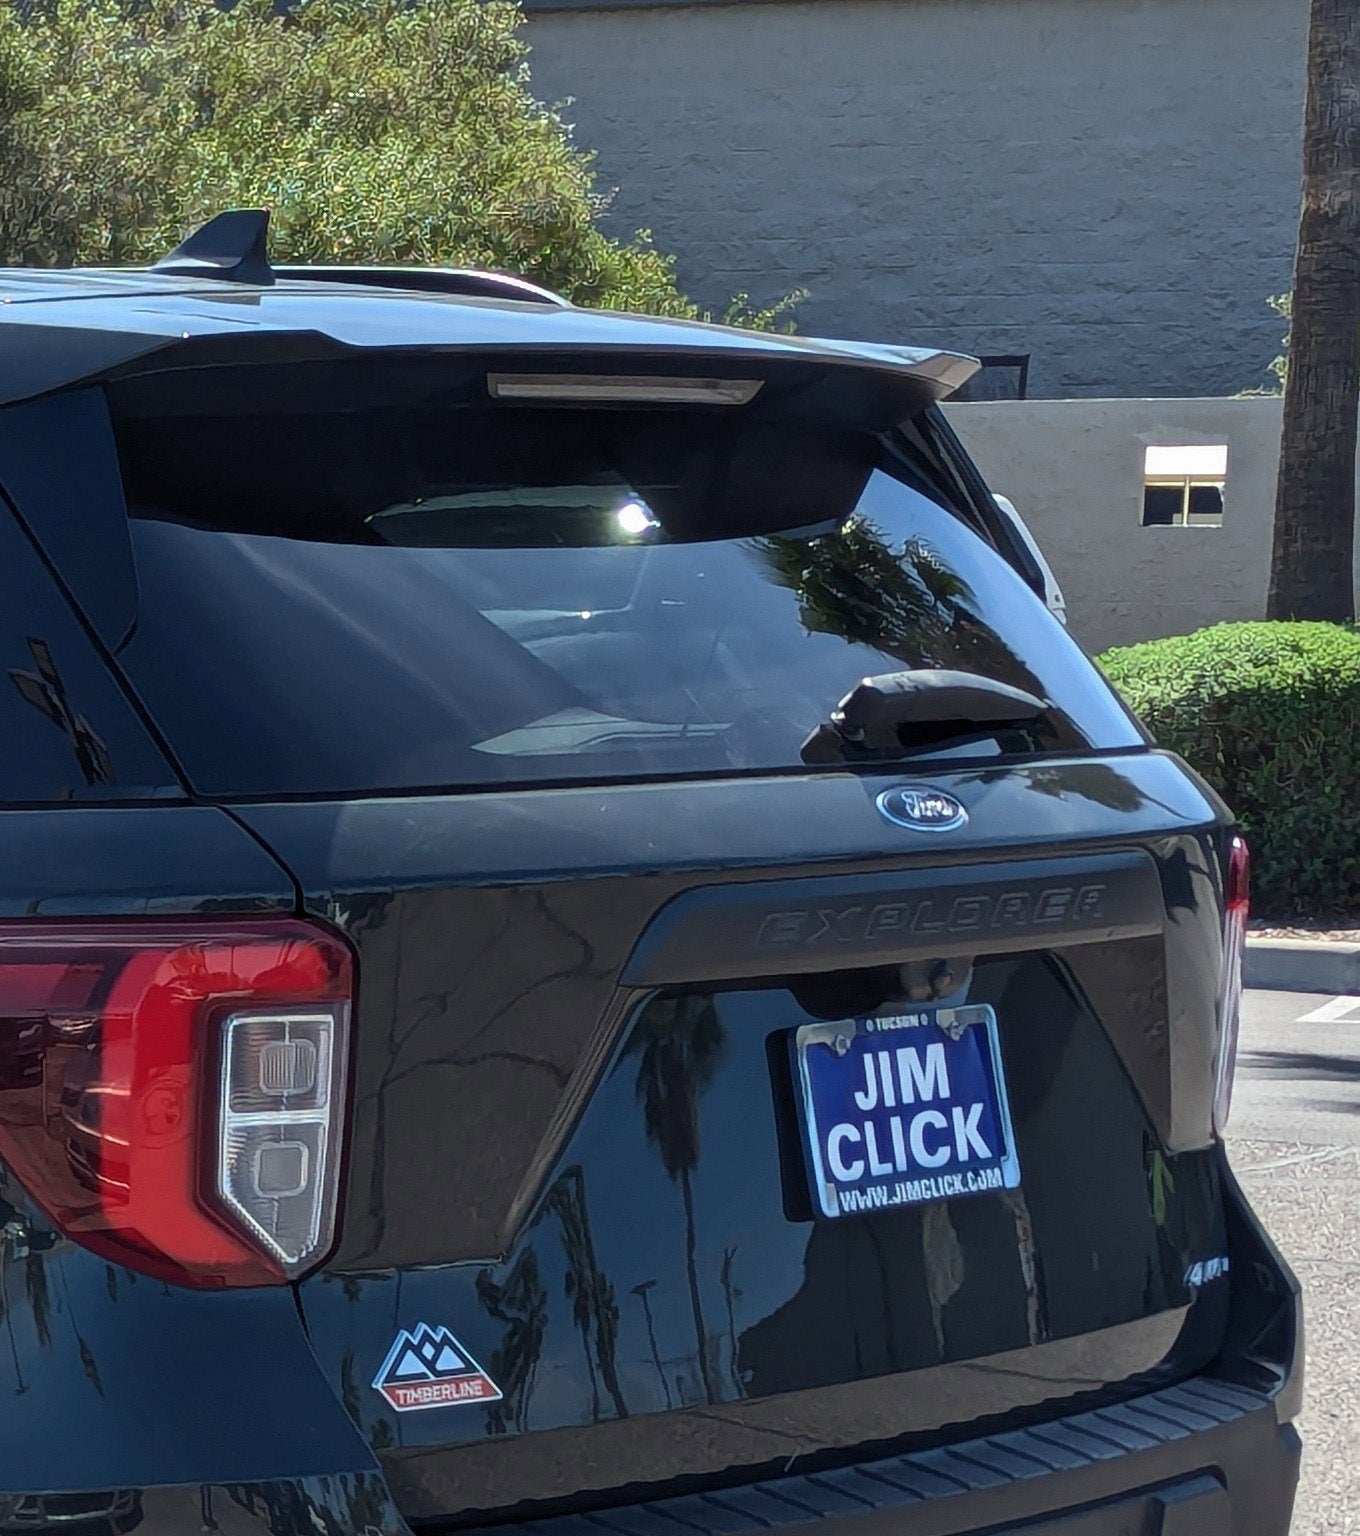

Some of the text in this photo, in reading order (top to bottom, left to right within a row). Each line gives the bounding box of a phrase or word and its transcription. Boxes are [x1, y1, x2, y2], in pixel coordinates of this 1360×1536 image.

[755, 884, 1107, 945] EXPLORER
[854, 1042, 950, 1111] JIM
[827, 1102, 993, 1182] CLICK
[395, 1380, 484, 1406] TIMBERLINE
